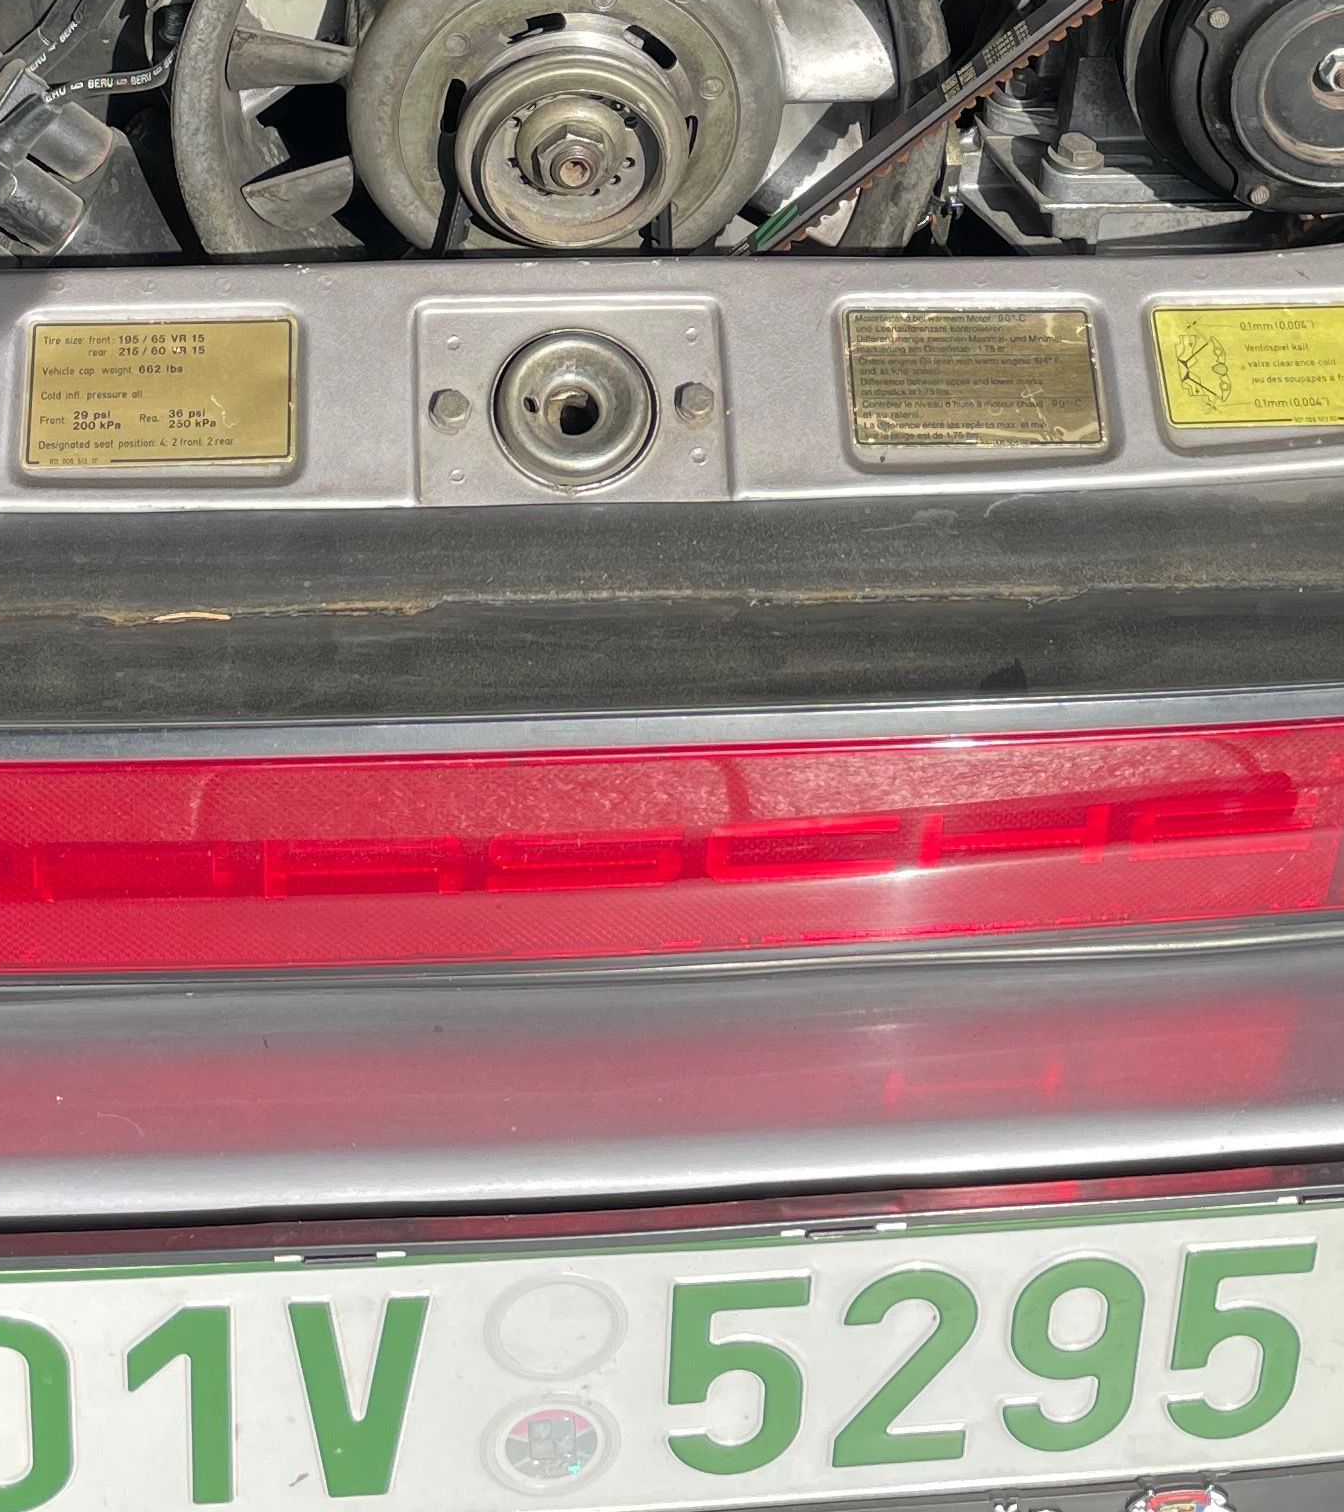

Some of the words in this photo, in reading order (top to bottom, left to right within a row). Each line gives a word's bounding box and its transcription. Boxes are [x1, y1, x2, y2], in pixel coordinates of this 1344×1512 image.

[87, 77, 114, 89] BERU
[130, 72, 152, 86] BERU
[855, 324, 872, 333] und
[43, 336, 61, 345] Tire
[118, 334, 139, 344] 195
[150, 334, 166, 343] 65
[171, 334, 187, 343] VR
[191, 333, 205, 343] 15
[1009, 334, 1027, 343] und
[118, 346, 139, 356] 215
[150, 346, 166, 356] 60
[192, 345, 206, 355] 15
[1244, 343, 1289, 353] Ventilspiel
[1291, 342, 1310, 351] kalt
[858, 357, 886, 365] Check
[887, 357, 918, 366] engine
[1247, 360, 1271, 368] valve
[1273, 358, 1316, 367] clearance
[1317, 357, 1337, 366] cold
[42, 366, 75, 376] Vehicle
[166, 364, 184, 374] lbs
[860, 367, 877, 375] and
[860, 377, 905, 386] Difference
[1251, 375, 1265, 385] jeu
[1266, 374, 1282, 383] des
[1284, 374, 1327, 385] soupapes
[40, 391, 61, 400] Cold
[86, 390, 127, 401] pressure
[874, 387, 908, 397] dipstick
[861, 399, 903, 409] Contrôler
[914, 399, 943, 409] niveau
[984, 399, 1015, 408] moteur
[73, 410, 88, 420] 29
[93, 409, 111, 421] psi
[188, 408, 206, 419] psi
[876, 410, 888, 419] au
[72, 421, 96, 431] 200
[99, 420, 122, 430] kPa
[195, 418, 217, 428] kPa
[922, 420, 945, 429] entre
[946, 419, 960, 429] les
[931, 431, 944, 440] de
[38, 439, 91, 451] Designated
[94, 439, 114, 449] seat
[214, 437, 235, 446] rear
[667, 1244, 1316, 1474] 5295
